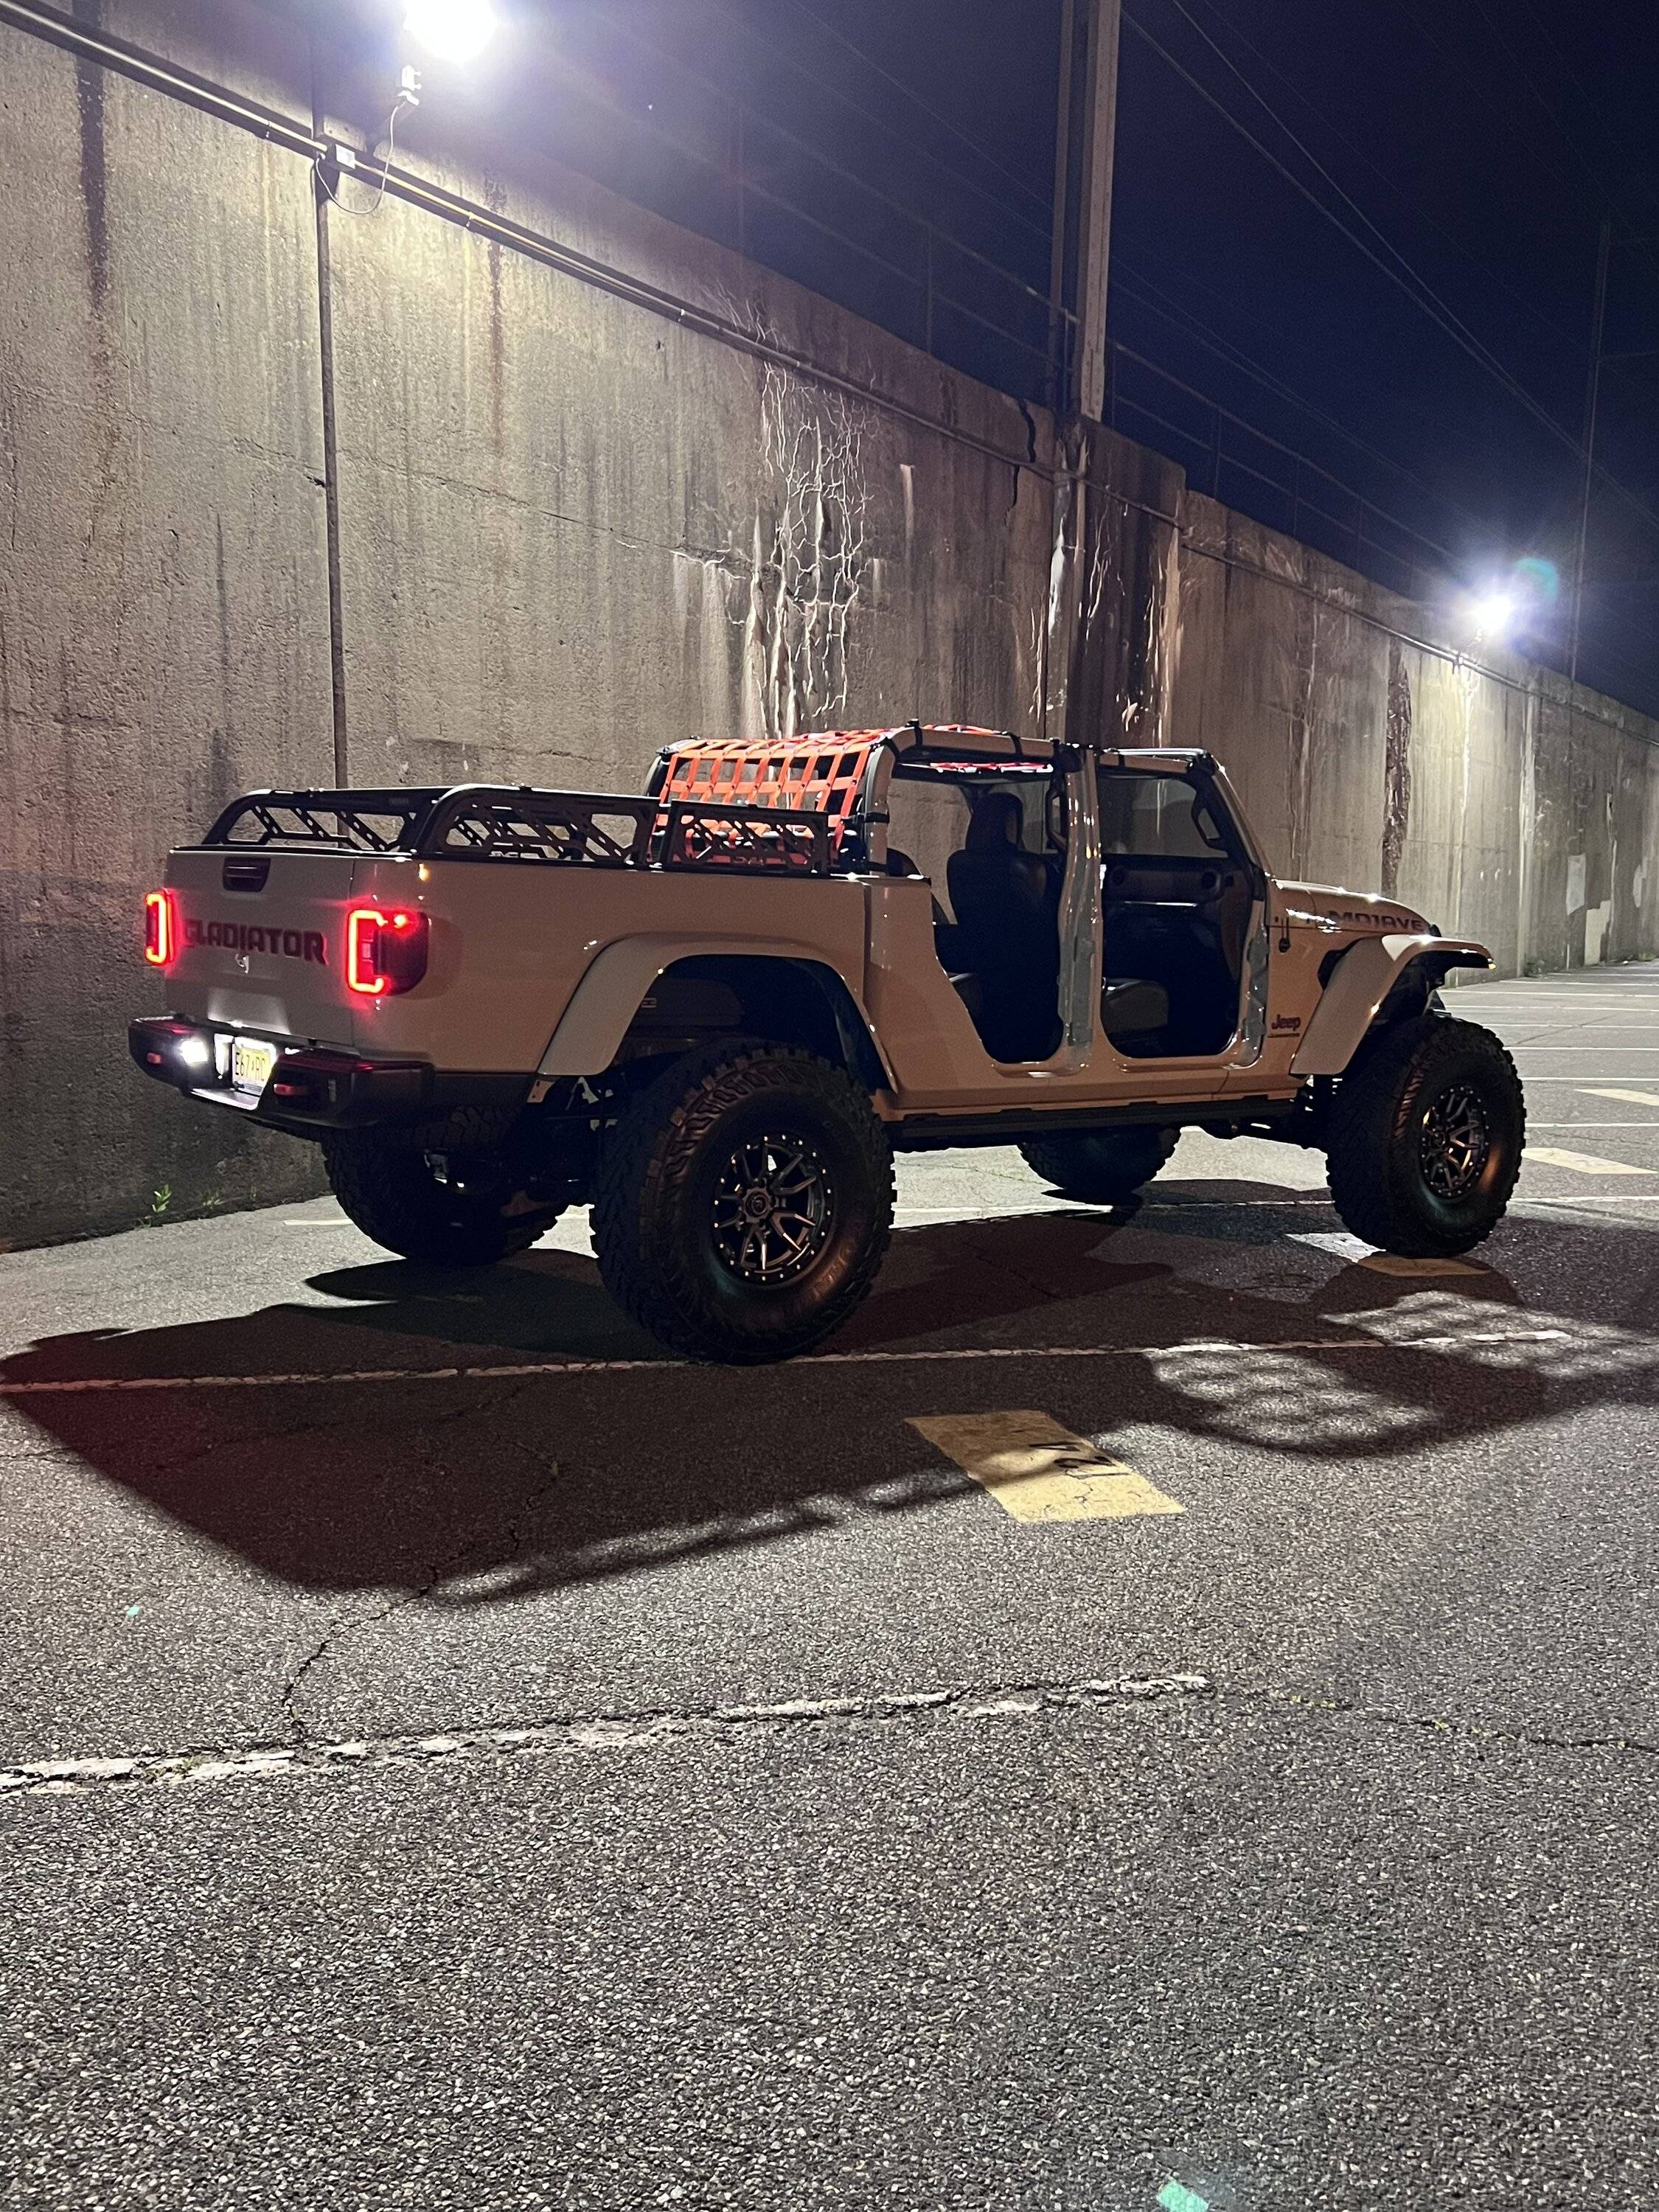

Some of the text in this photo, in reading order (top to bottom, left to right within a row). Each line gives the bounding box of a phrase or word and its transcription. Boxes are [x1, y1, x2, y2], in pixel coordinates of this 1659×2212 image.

[1328, 910, 1426, 932] MOJAVE
[184, 919, 329, 966] GLADIATOR
[1271, 1014, 1301, 1032] Jeep
